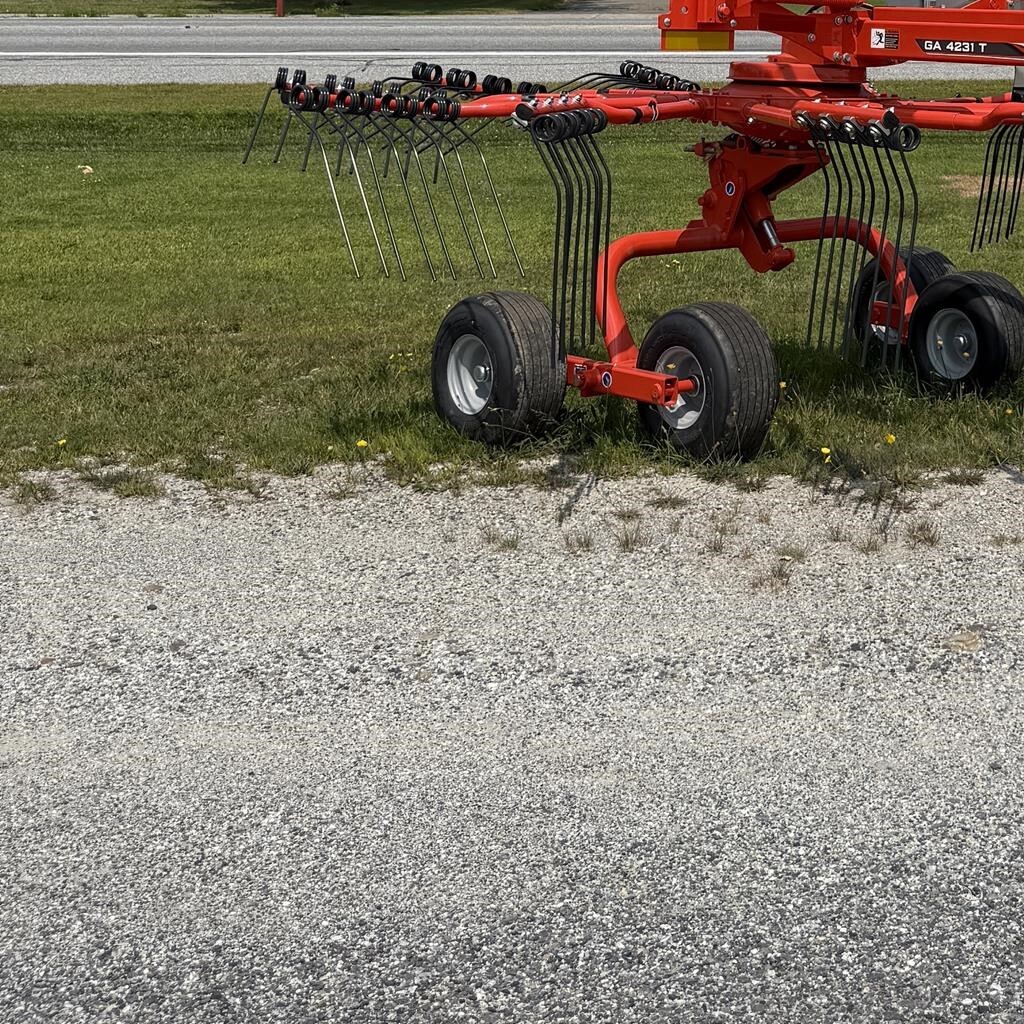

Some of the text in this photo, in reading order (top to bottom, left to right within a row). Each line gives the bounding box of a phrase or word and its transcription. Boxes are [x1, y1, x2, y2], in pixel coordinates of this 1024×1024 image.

[924, 40, 988, 53] GA 4231 T
